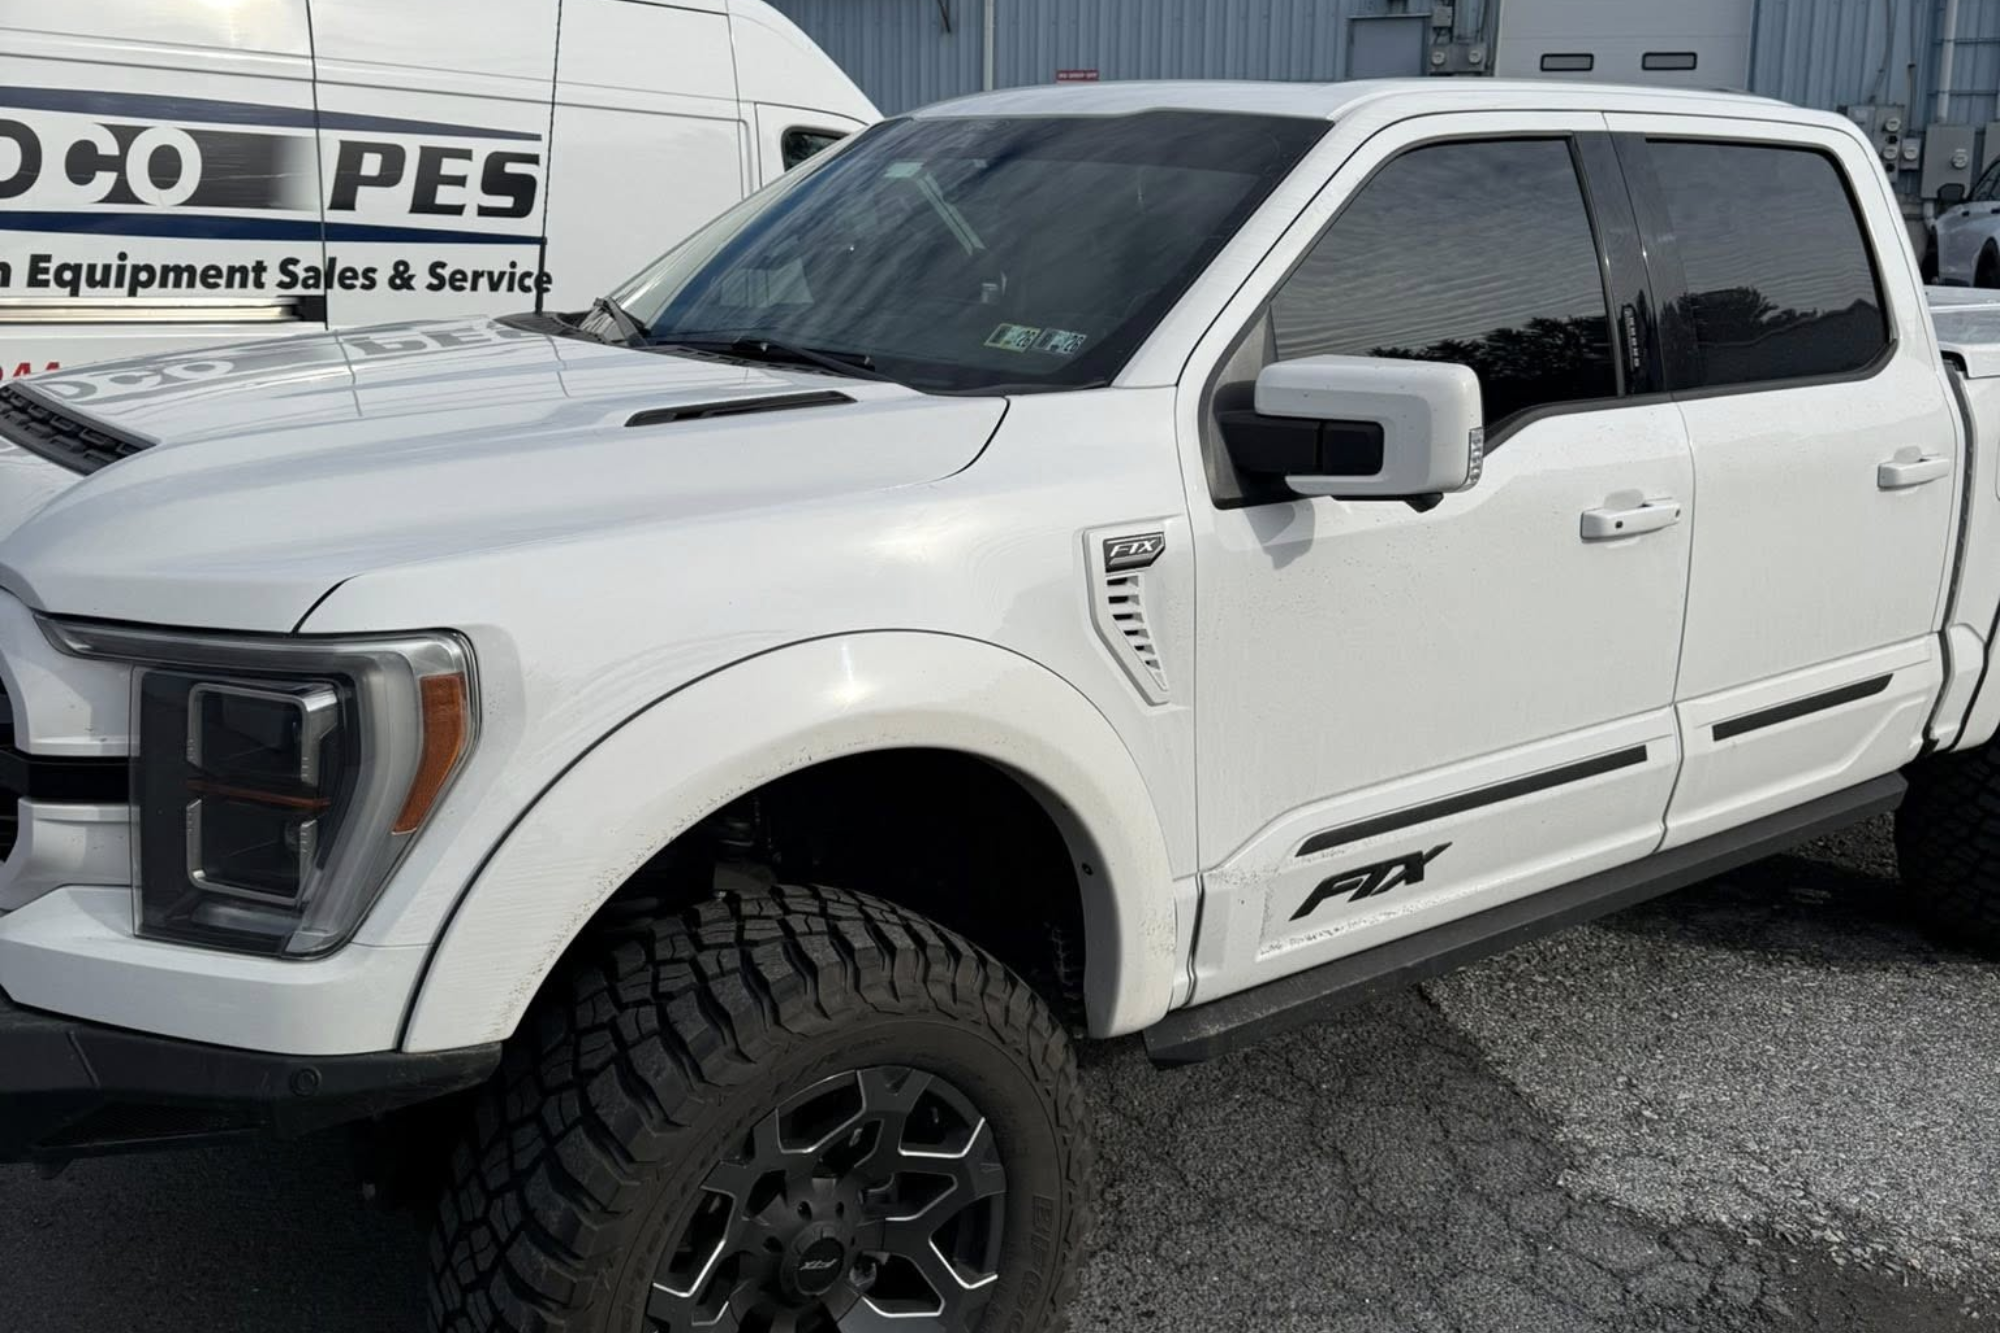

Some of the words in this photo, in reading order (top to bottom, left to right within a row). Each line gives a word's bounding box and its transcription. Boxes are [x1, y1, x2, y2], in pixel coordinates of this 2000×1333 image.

[327, 139, 541, 219] PES
[26, 252, 267, 297] Equipment
[275, 257, 378, 290] Sales
[387, 259, 416, 291] &
[425, 260, 553, 294] Service
[1288, 841, 1453, 922] FTX
